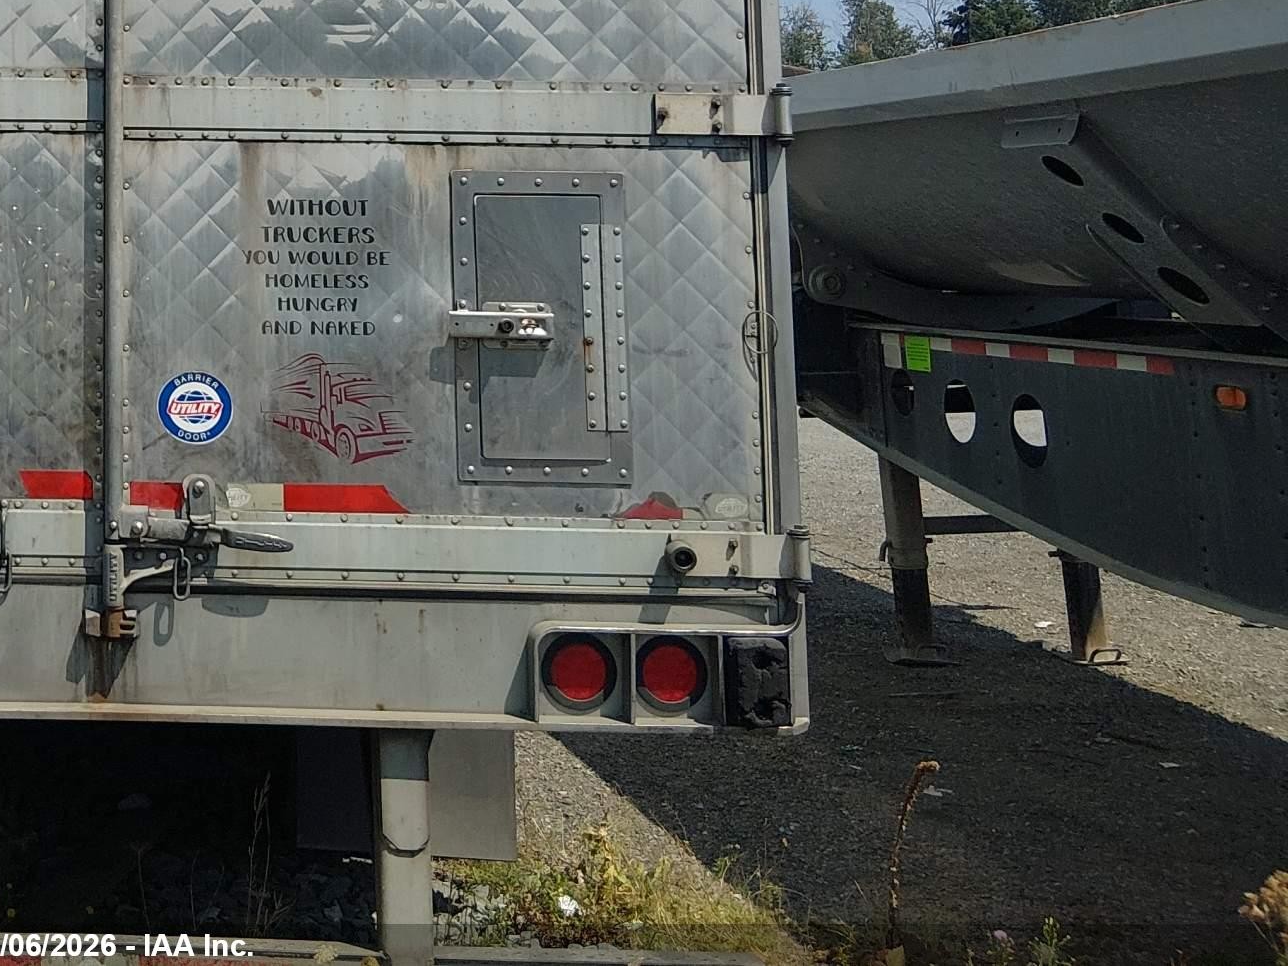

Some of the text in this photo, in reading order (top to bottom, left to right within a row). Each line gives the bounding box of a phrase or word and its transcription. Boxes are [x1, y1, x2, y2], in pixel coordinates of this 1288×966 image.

[267, 199, 368, 216] WITHOUT
[261, 226, 375, 244] TRUCKERS
[242, 250, 392, 266] YOU WOULD BE
[265, 273, 369, 289] HOMELESS
[278, 297, 358, 312] HUNGRY
[261, 320, 376, 336] AND NAKED
[173, 373, 220, 389] BARRIER
[170, 402, 220, 414] UTILITY
